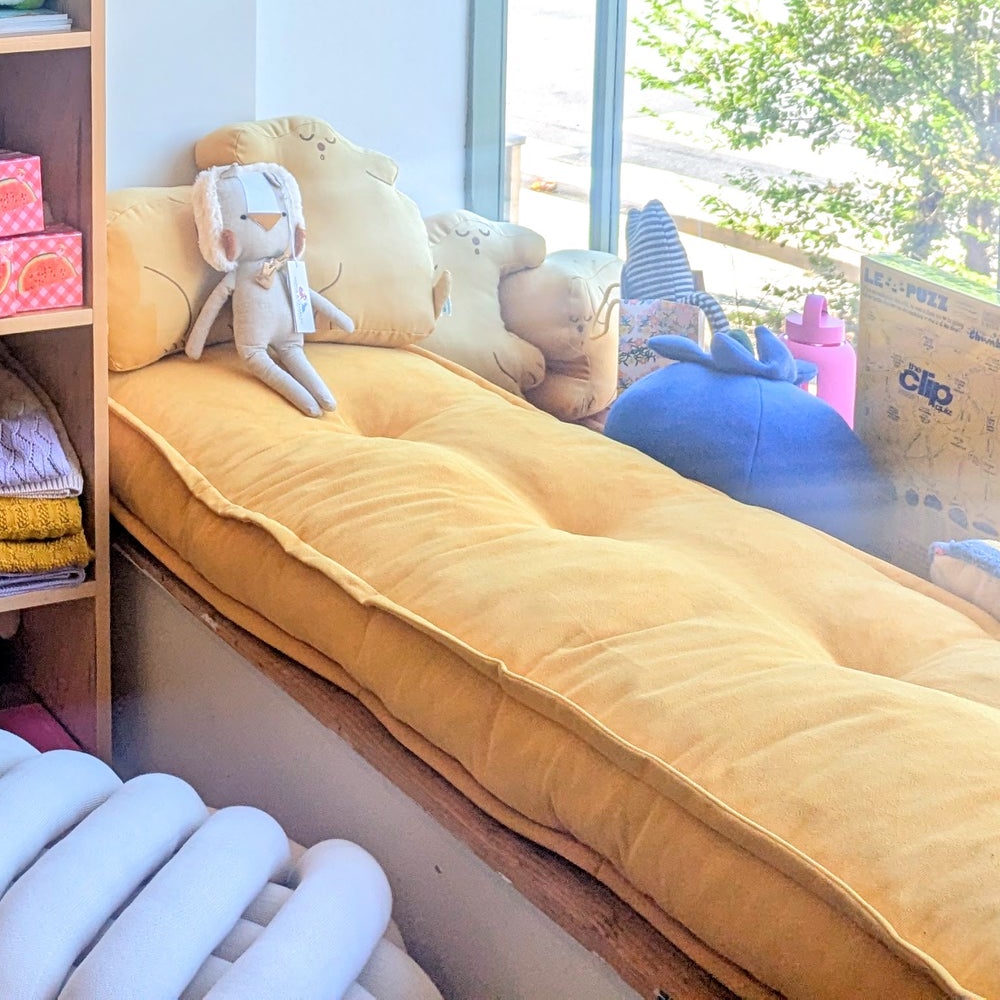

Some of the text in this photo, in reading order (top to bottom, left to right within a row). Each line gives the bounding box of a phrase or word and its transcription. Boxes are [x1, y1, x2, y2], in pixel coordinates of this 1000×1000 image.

[864, 268, 883, 288] LE
[906, 283, 948, 312] PUZZ
[899, 369, 953, 406] clip
